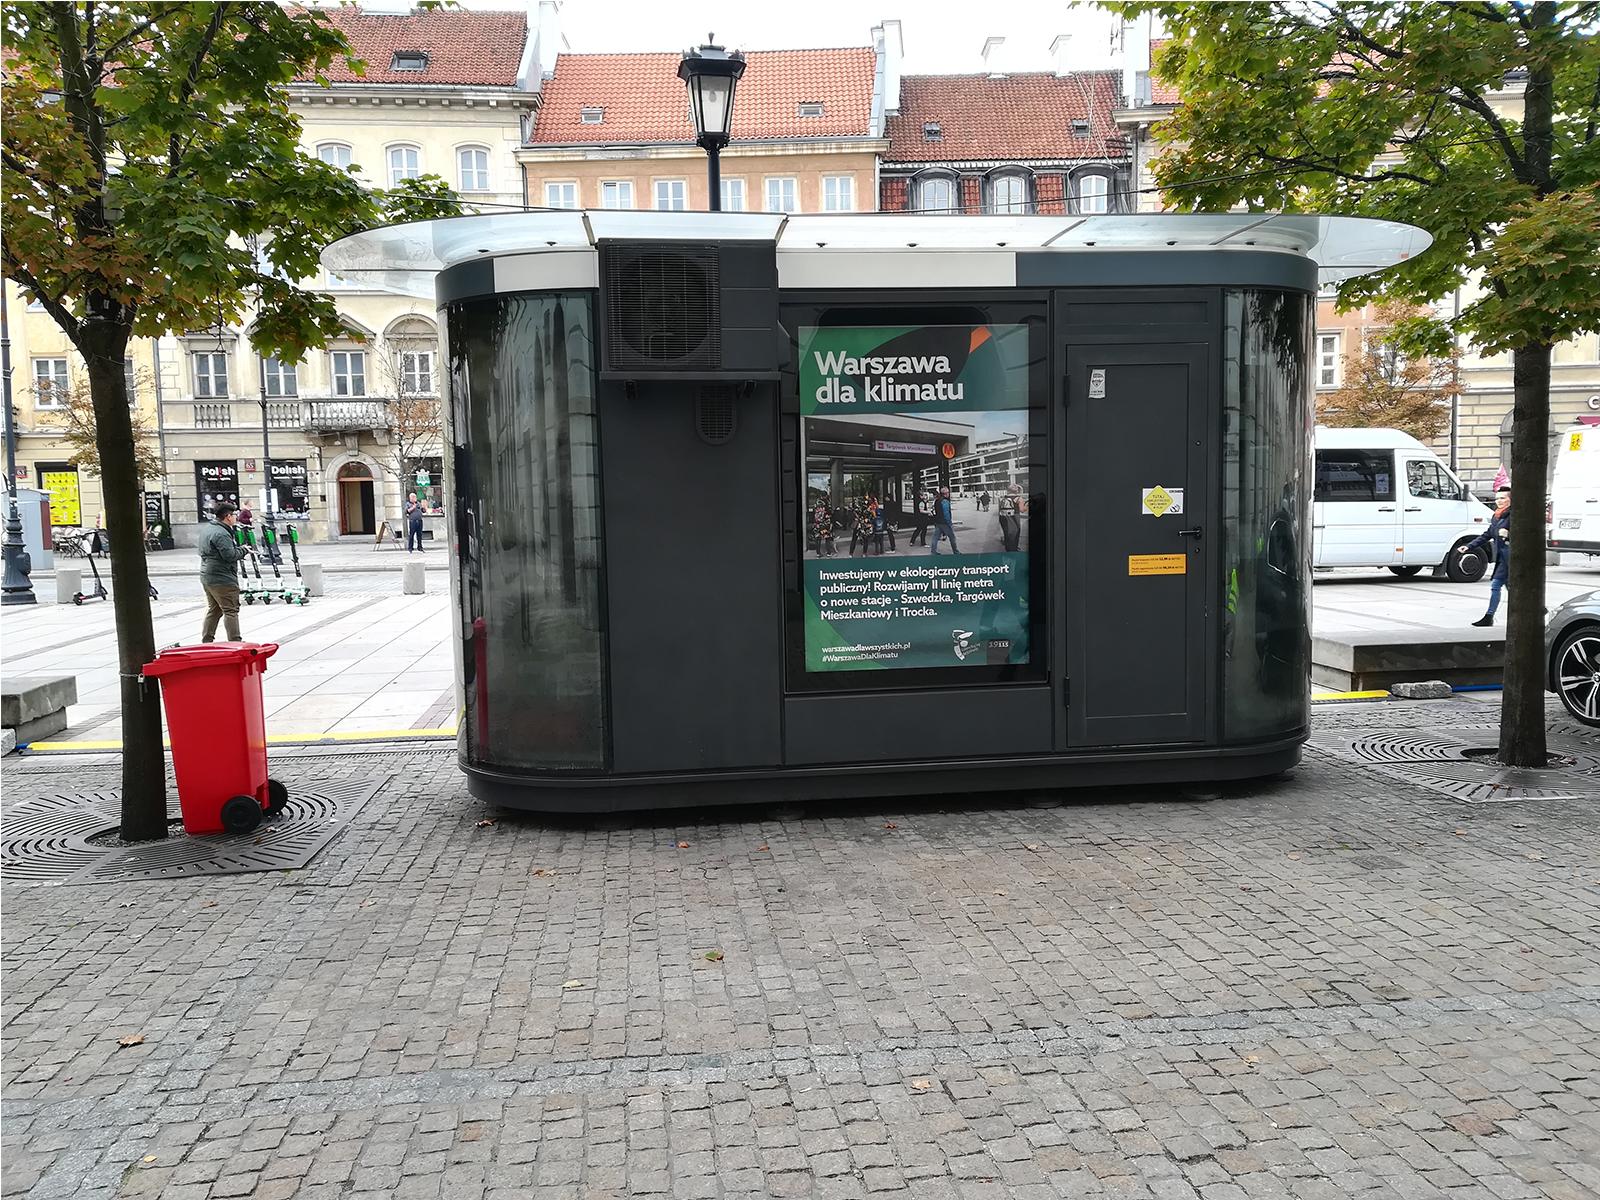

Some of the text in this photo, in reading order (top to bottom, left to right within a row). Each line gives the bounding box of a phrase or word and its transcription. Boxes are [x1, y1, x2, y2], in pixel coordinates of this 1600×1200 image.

[814, 350, 952, 376] Warszawa
[815, 376, 964, 404] dla klimatu
[201, 465, 235, 476] Polish
[271, 465, 305, 475] Delish
[819, 569, 885, 581] Inwestujemy
[899, 566, 960, 579] ekologiczny
[962, 564, 1010, 576] transport
[820, 578, 994, 596] publiczny! Rozwijamy II linię metra
[820, 599, 828, 607] o
[830, 598, 858, 607] nowe
[861, 594, 892, 607] stacje
[901, 592, 954, 604] Szwedzka,
[956, 589, 1005, 603] Targówek
[820, 606, 938, 621] Mieszkaniowy i Trocka.
[821, 642, 911, 653] warszawadlawszystkich.pl
[822, 652, 898, 662] #WarszawaDlaKlimatu
